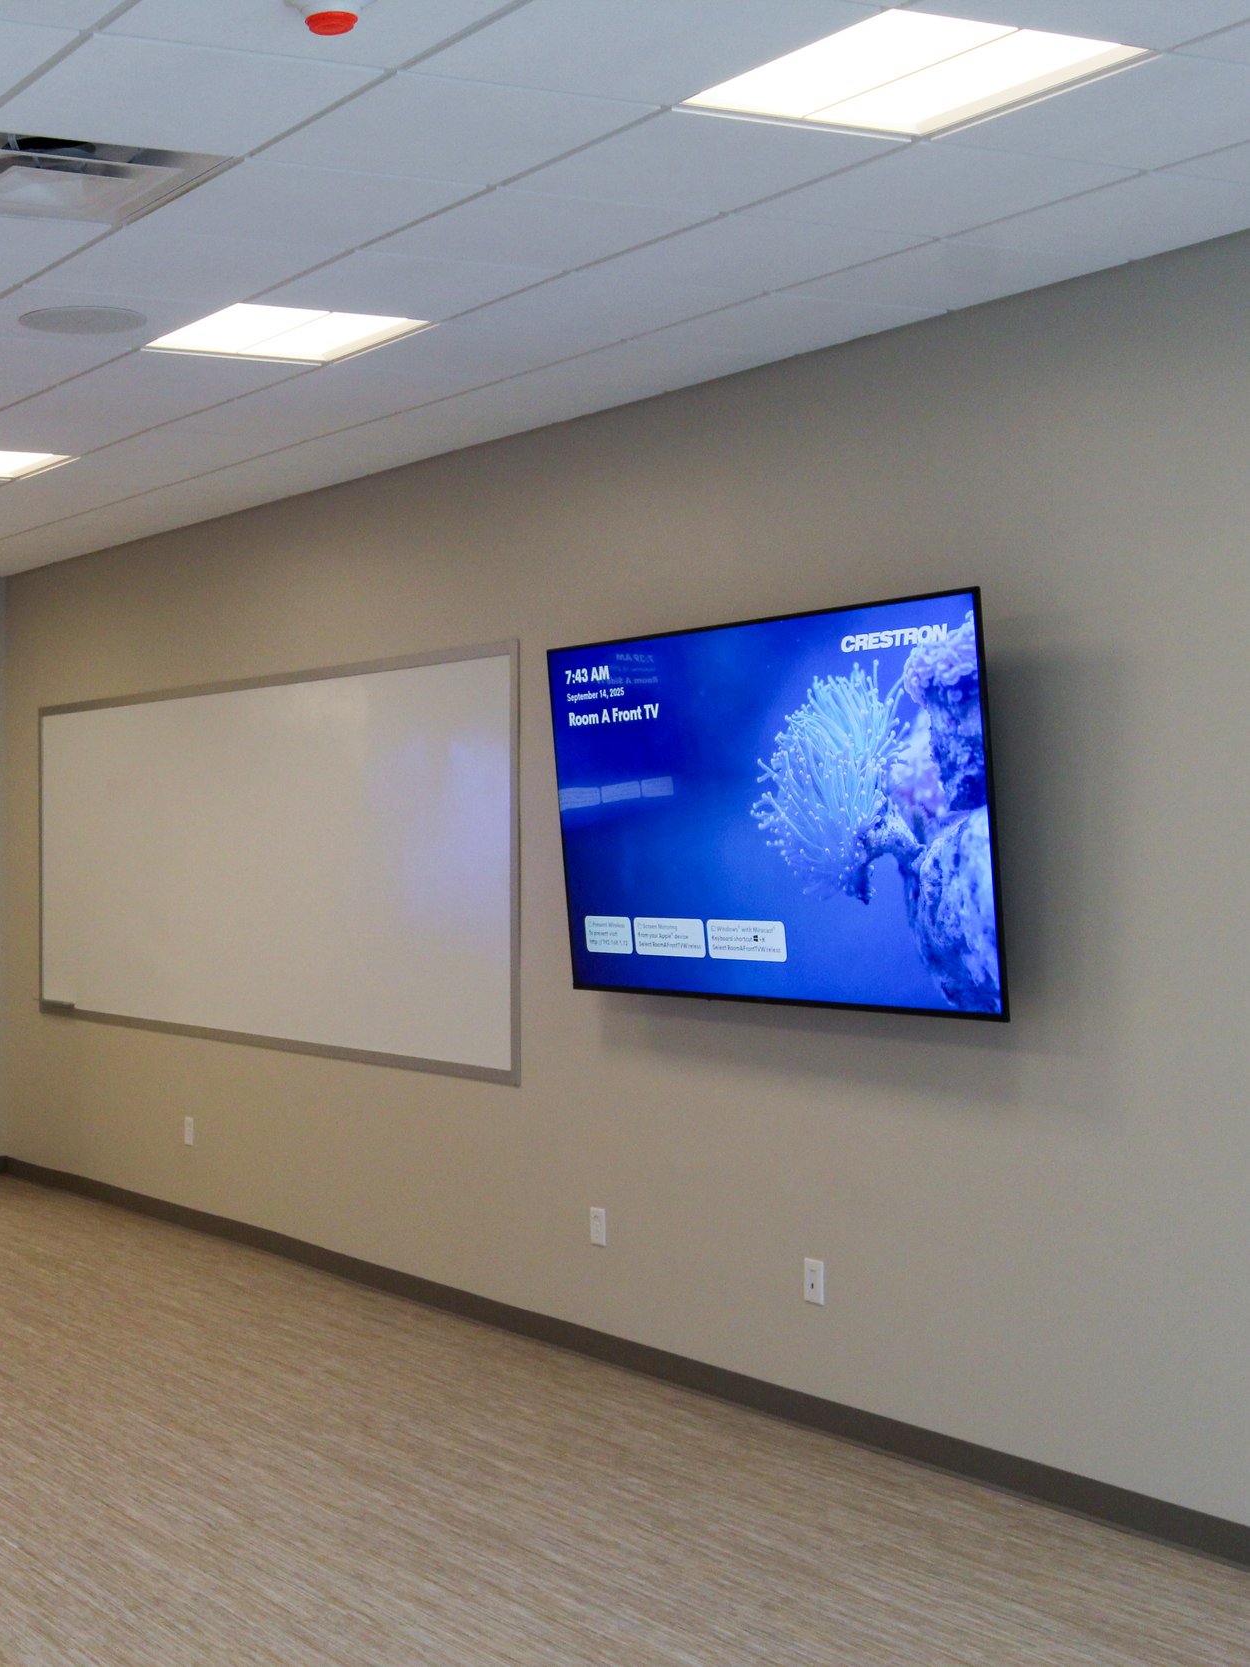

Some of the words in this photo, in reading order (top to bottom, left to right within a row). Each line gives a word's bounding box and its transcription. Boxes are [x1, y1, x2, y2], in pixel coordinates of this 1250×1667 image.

[840, 623, 948, 653] CRESTRON
[565, 668, 588, 685] 7:43
[591, 665, 610, 682] AM
[567, 690, 598, 703] September
[599, 689, 609, 699] 14,
[610, 687, 625, 697] 2025
[568, 712, 599, 727] Room
[601, 708, 610, 723] A
[612, 705, 642, 722] Front
[643, 703, 659, 719] TV
